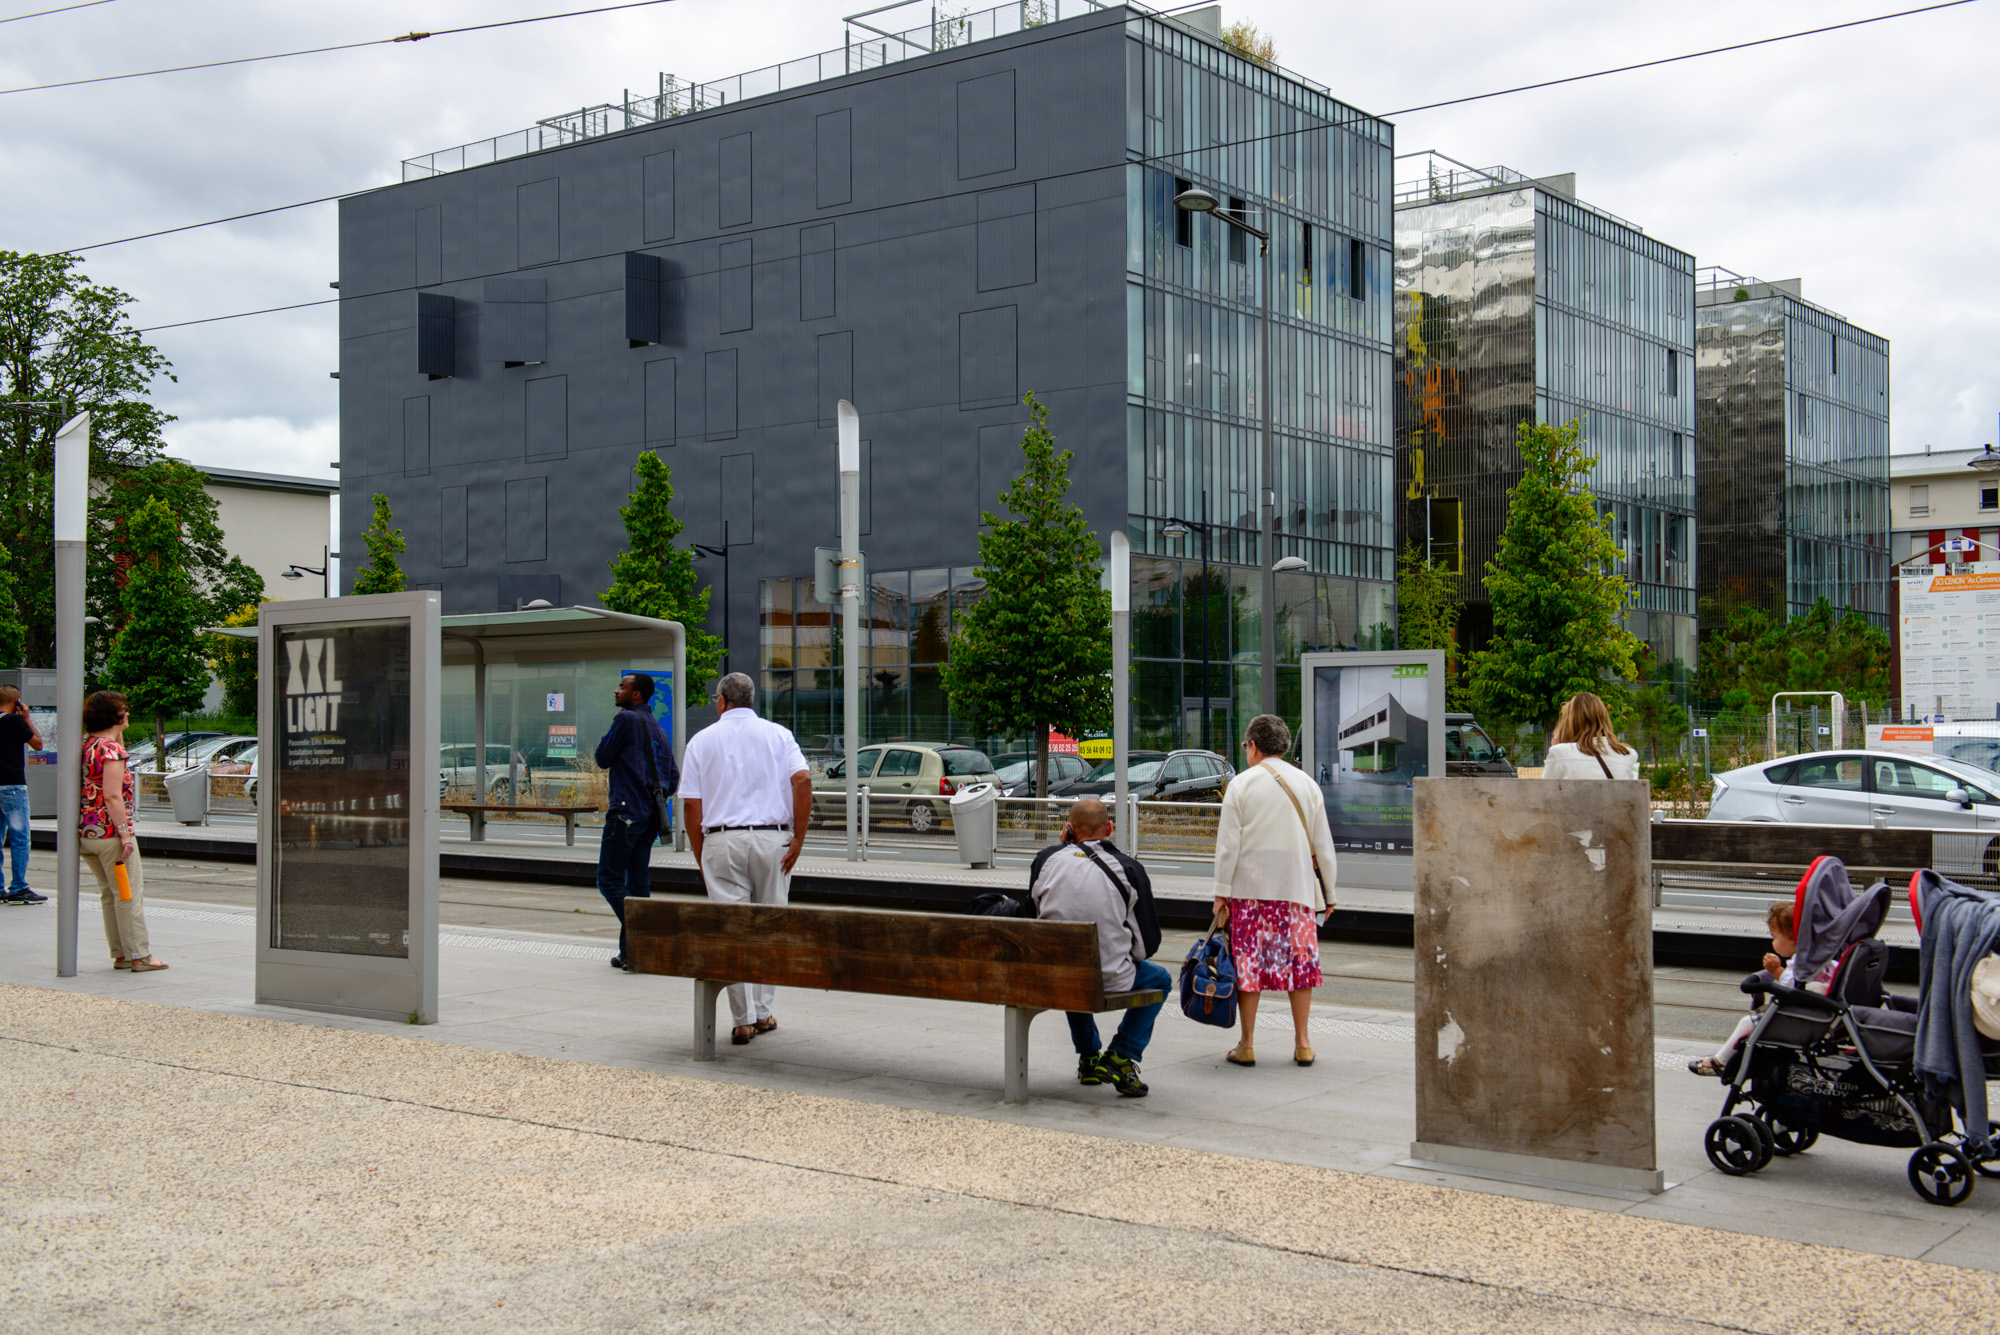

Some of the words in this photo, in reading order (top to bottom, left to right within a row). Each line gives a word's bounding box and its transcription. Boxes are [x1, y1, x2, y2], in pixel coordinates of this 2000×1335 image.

[1945, 576, 1965, 585] CENON
[286, 638, 343, 695] XXL
[287, 695, 342, 733] LIGHT
[288, 748, 313, 756] Installation
[330, 756, 345, 764] 2012
[1813, 1085, 1849, 1099] baby
